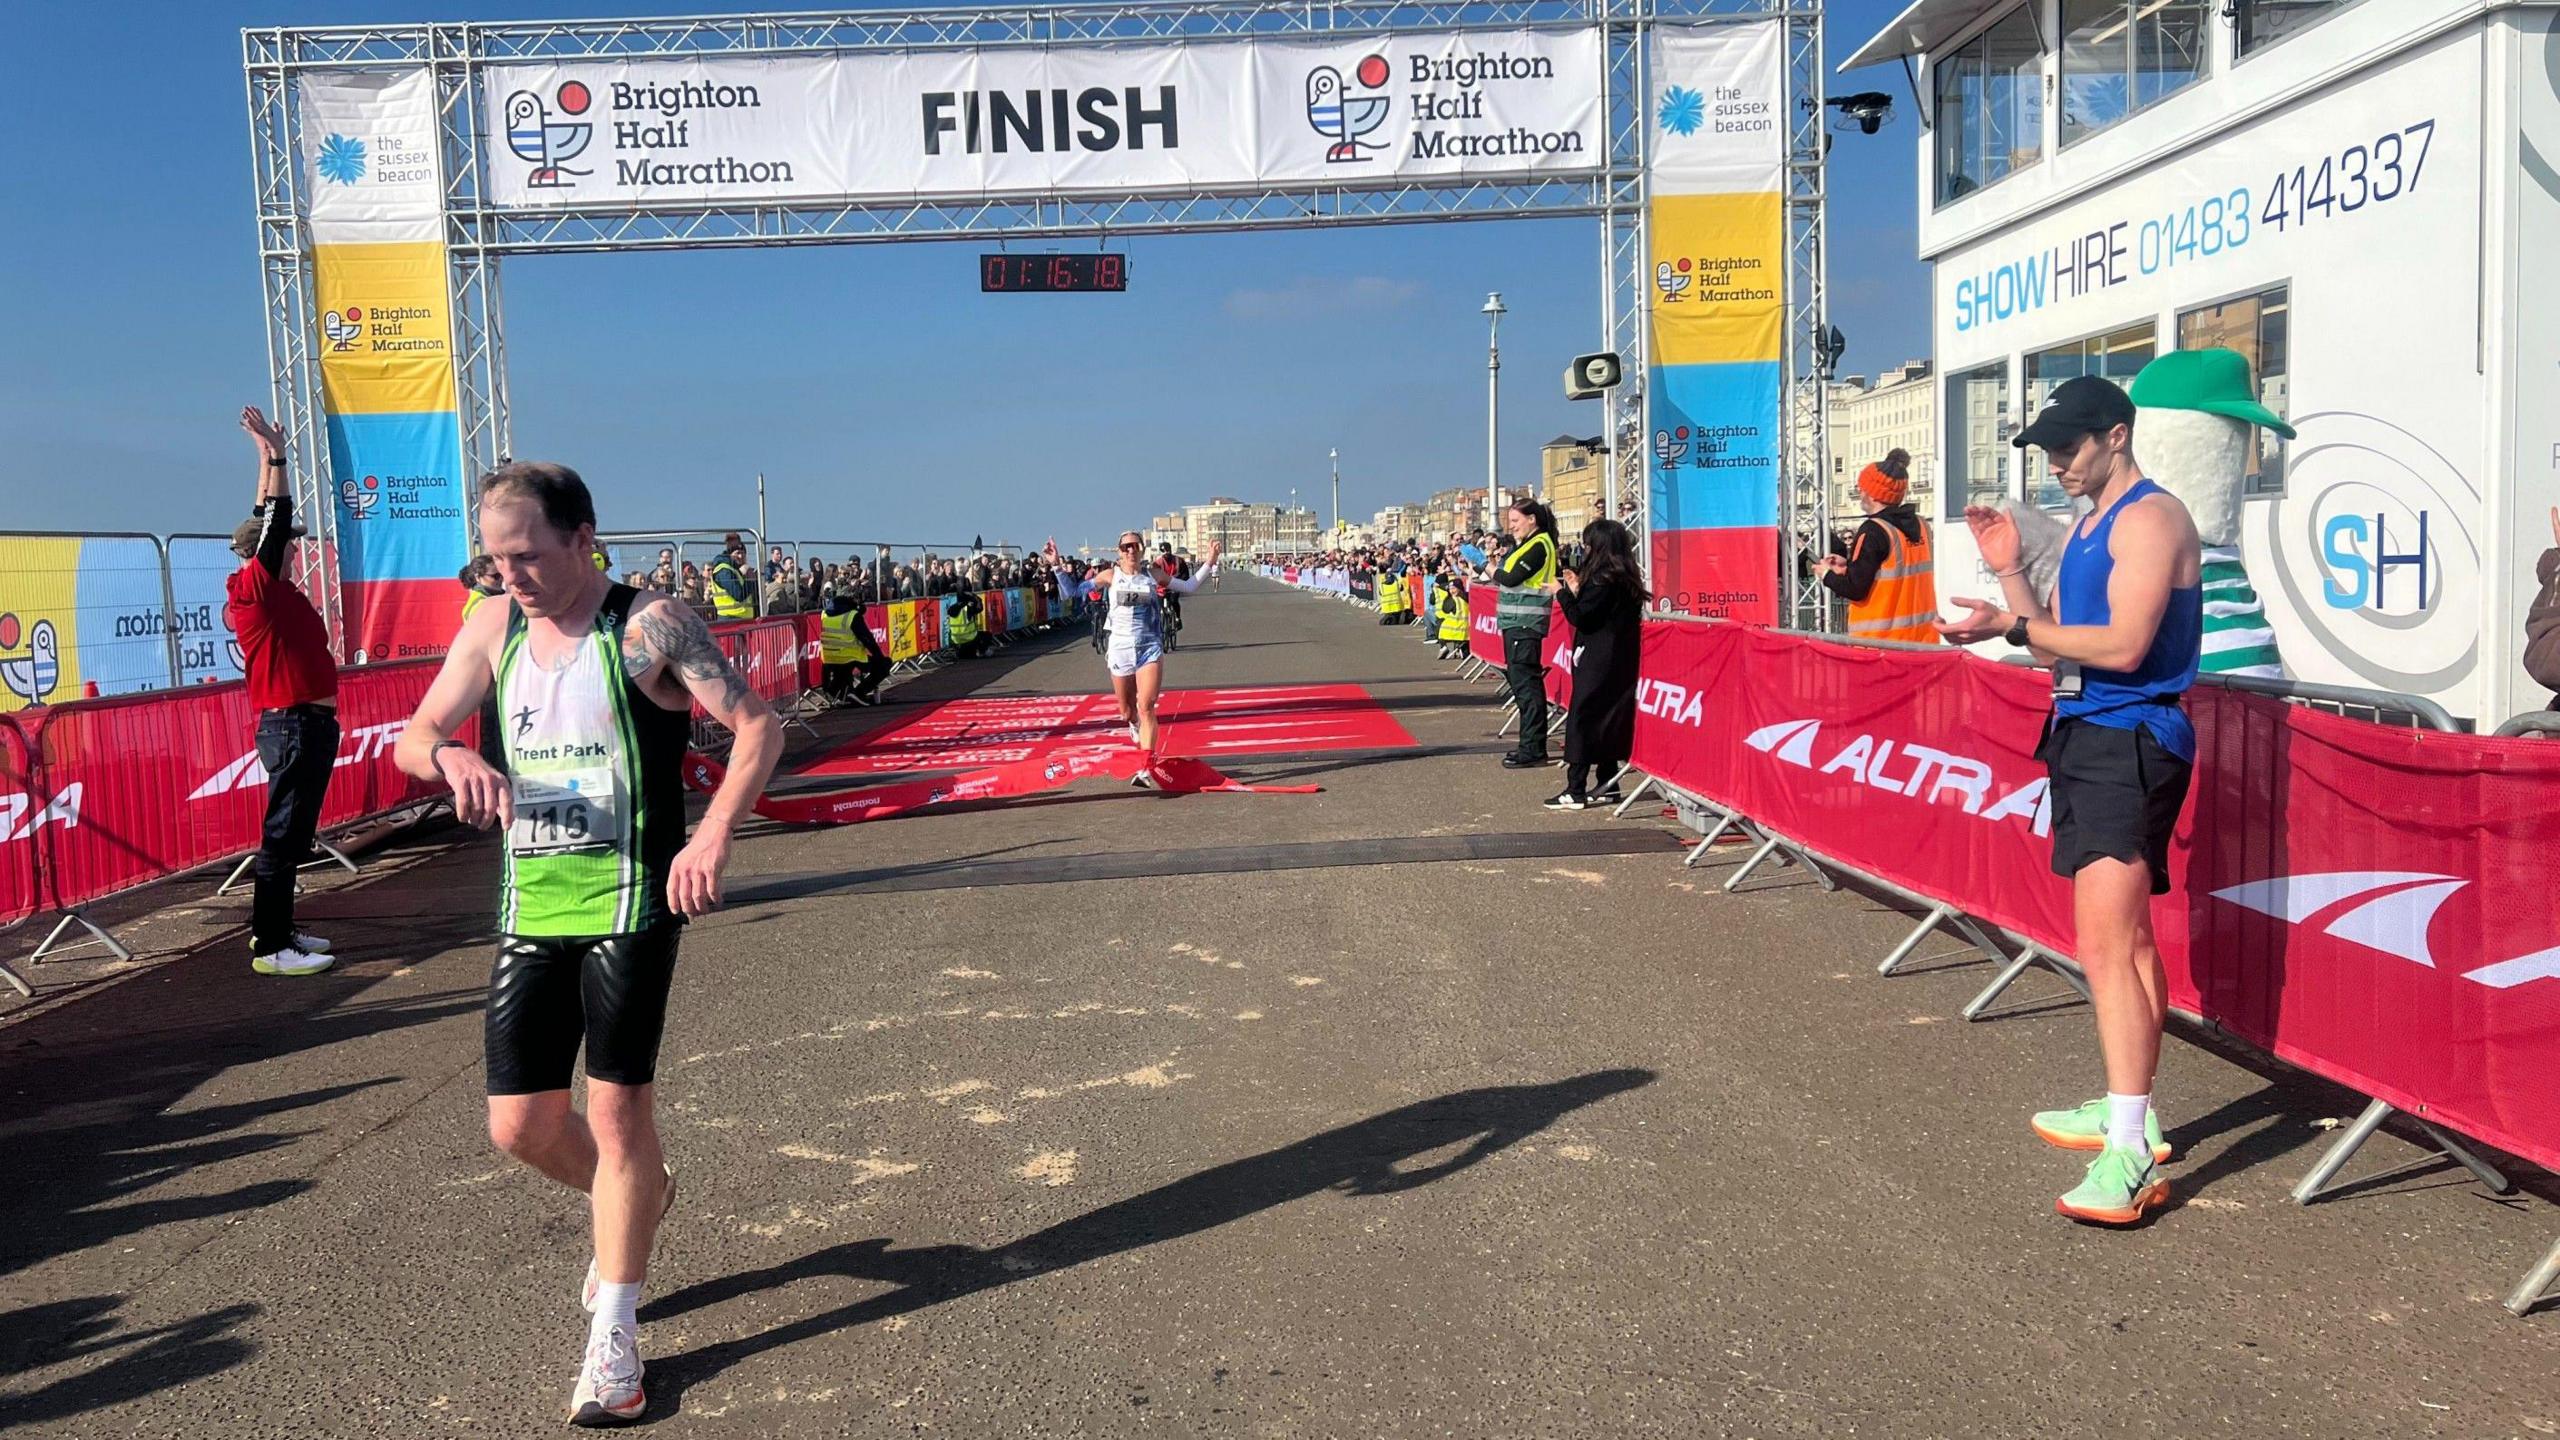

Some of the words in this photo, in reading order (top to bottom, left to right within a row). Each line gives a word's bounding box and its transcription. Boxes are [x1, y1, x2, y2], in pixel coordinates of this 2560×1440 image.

[1409, 52, 1554, 89] Brighton
[611, 80, 761, 117] Brighton
[1715, 86, 1742, 100] the
[1411, 91, 1483, 122] Half
[1715, 101, 1769, 116] sussex
[922, 85, 1179, 156] FINISH
[1715, 118, 1772, 133] beacon
[614, 121, 689, 150] Half
[1413, 126, 1583, 160] Marathon
[377, 136, 403, 151] the
[377, 152, 429, 167] sussex
[377, 166, 432, 183] beacon
[616, 157, 794, 187] Marathon
[2138, 187, 2251, 276] 01483
[2261, 118, 2436, 233] 414337
[1700, 257, 1762, 273] Brighton
[1700, 274, 1731, 286] Half
[1700, 288, 1774, 302] Marathon
[370, 307, 431, 322] Brighton
[371, 323, 403, 336] Half
[372, 338, 445, 352] Marathon
[1697, 425, 1758, 441] Brighton
[1697, 441, 1728, 454] Half
[1697, 455, 1770, 469] Marathon
[386, 476, 448, 491] Brighton
[388, 491, 419, 504] Half
[389, 506, 460, 520] Marathon
[2323, 510, 2428, 611] SH
[1698, 591, 1759, 606] Brighton
[1698, 607, 1729, 618] Half
[398, 643, 449, 657] Brighto
[516, 747, 558, 761] Trent
[563, 743, 607, 758] Park
[1820, 734, 2052, 838] ALTRA
